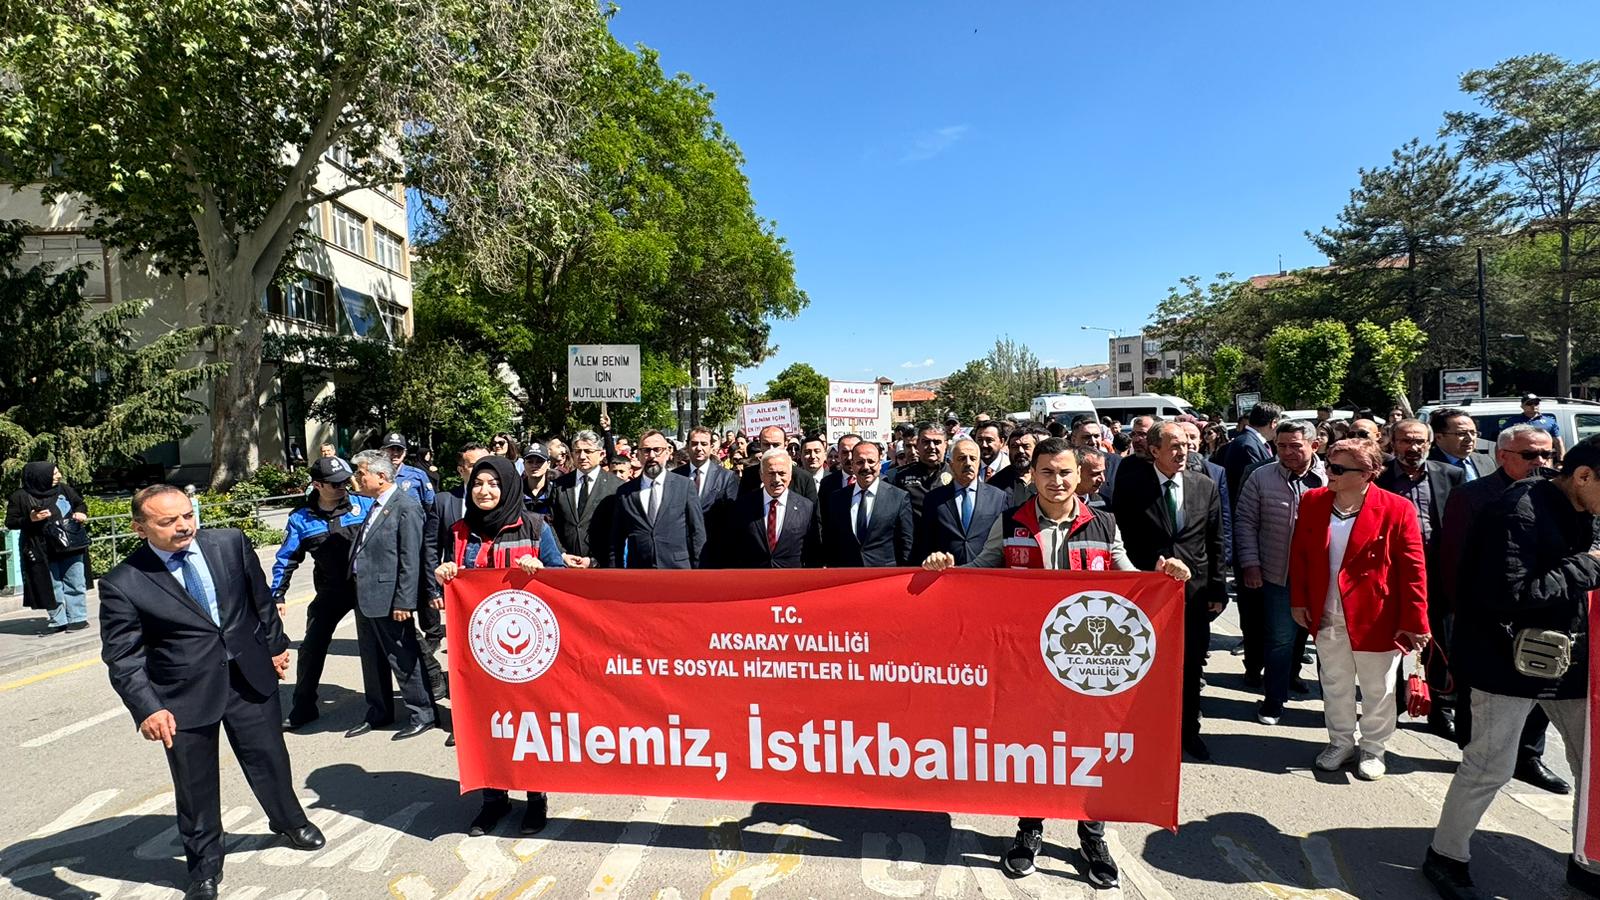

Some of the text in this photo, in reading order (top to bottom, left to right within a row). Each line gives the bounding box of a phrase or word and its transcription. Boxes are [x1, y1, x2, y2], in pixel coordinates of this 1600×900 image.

[573, 387, 636, 398] MUTLULUKTUR
[756, 406, 778, 414] AİLEM
[770, 605, 803, 624] T.C.
[709, 630, 870, 654] AKSARAY VALİLİĞİ
[1067, 657, 1132, 666] T.C. AKSARAY
[605, 654, 989, 687] AİLE VE SOSYAL HİZMETLER İL MÜDÜRLÜĞÜ
[1079, 666, 1119, 676] VALİLİĞİ
[490, 703, 1135, 788] “Ailemiz, İstikbalimiz”
